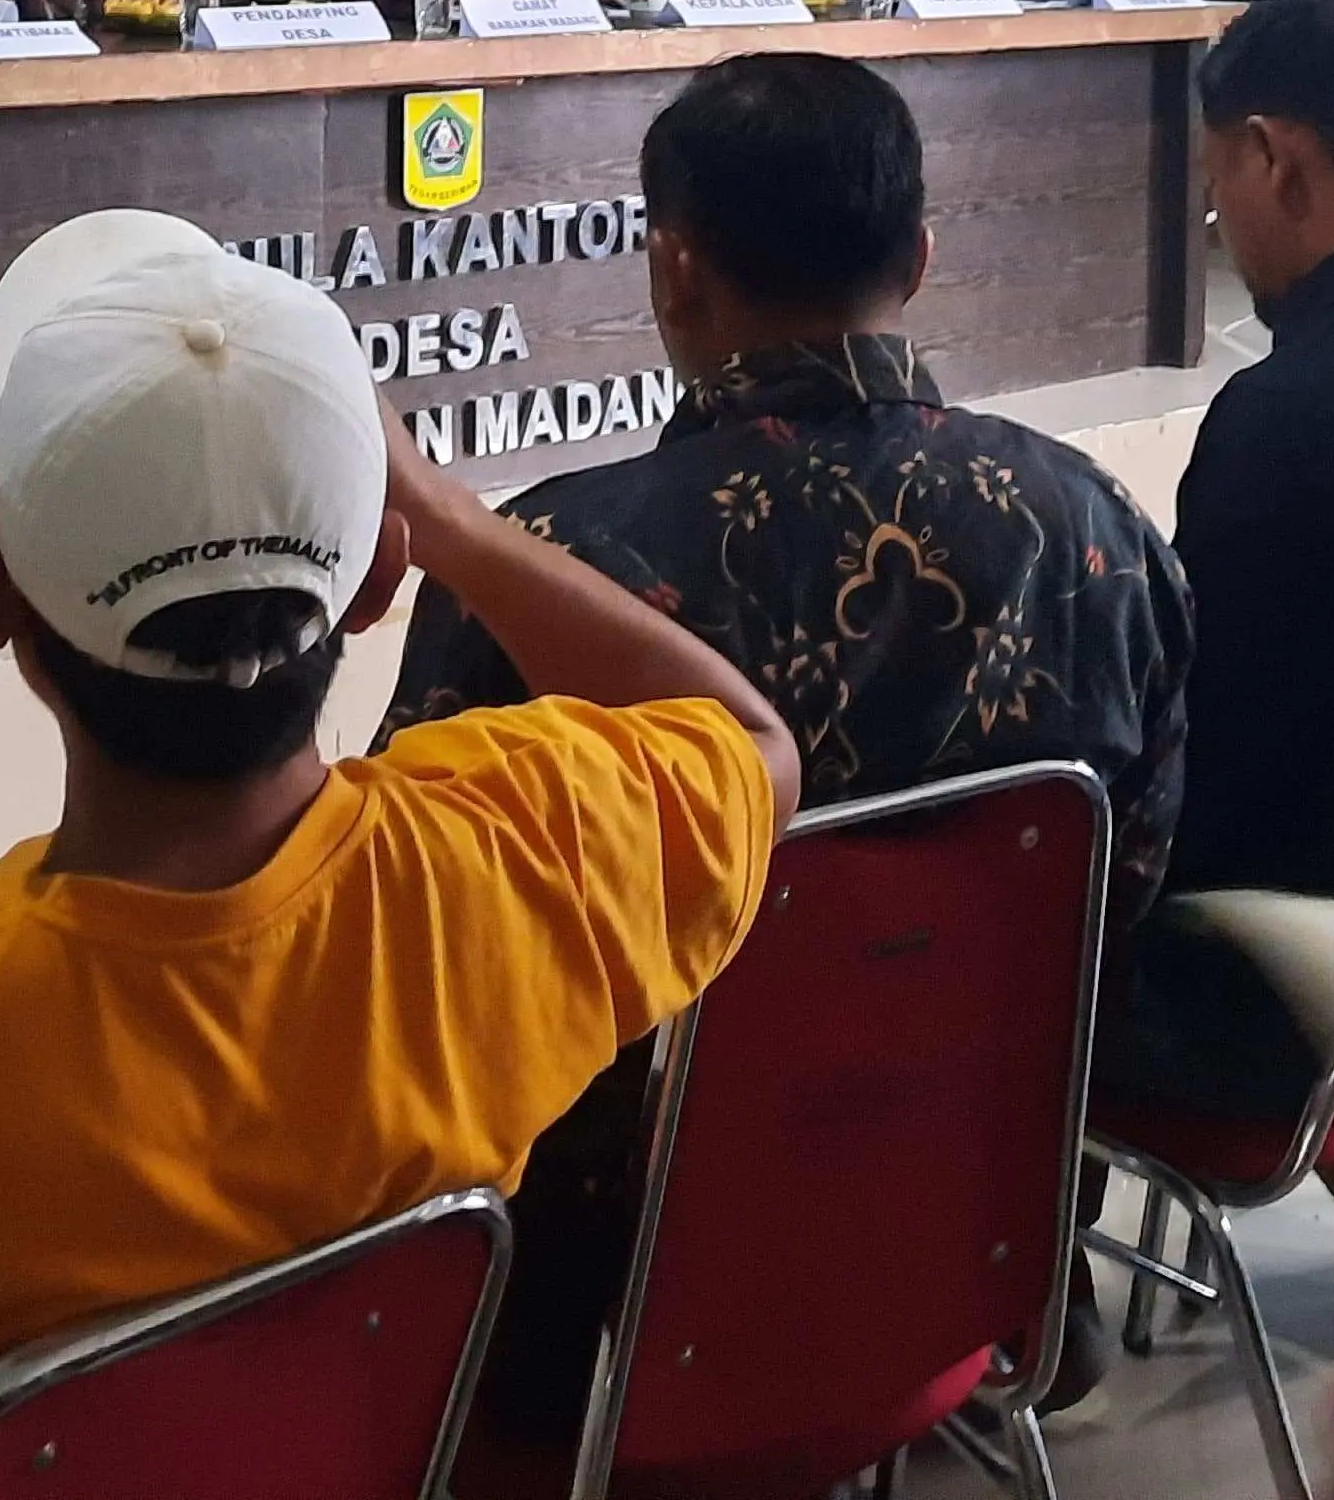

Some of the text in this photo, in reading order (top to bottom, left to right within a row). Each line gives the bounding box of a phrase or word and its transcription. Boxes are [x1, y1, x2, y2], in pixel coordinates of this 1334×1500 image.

[232, 5, 359, 23] PENDAMPING
[281, 27, 334, 41] DESA
[359, 301, 531, 384] DESA
[474, 365, 683, 459] MADAN
